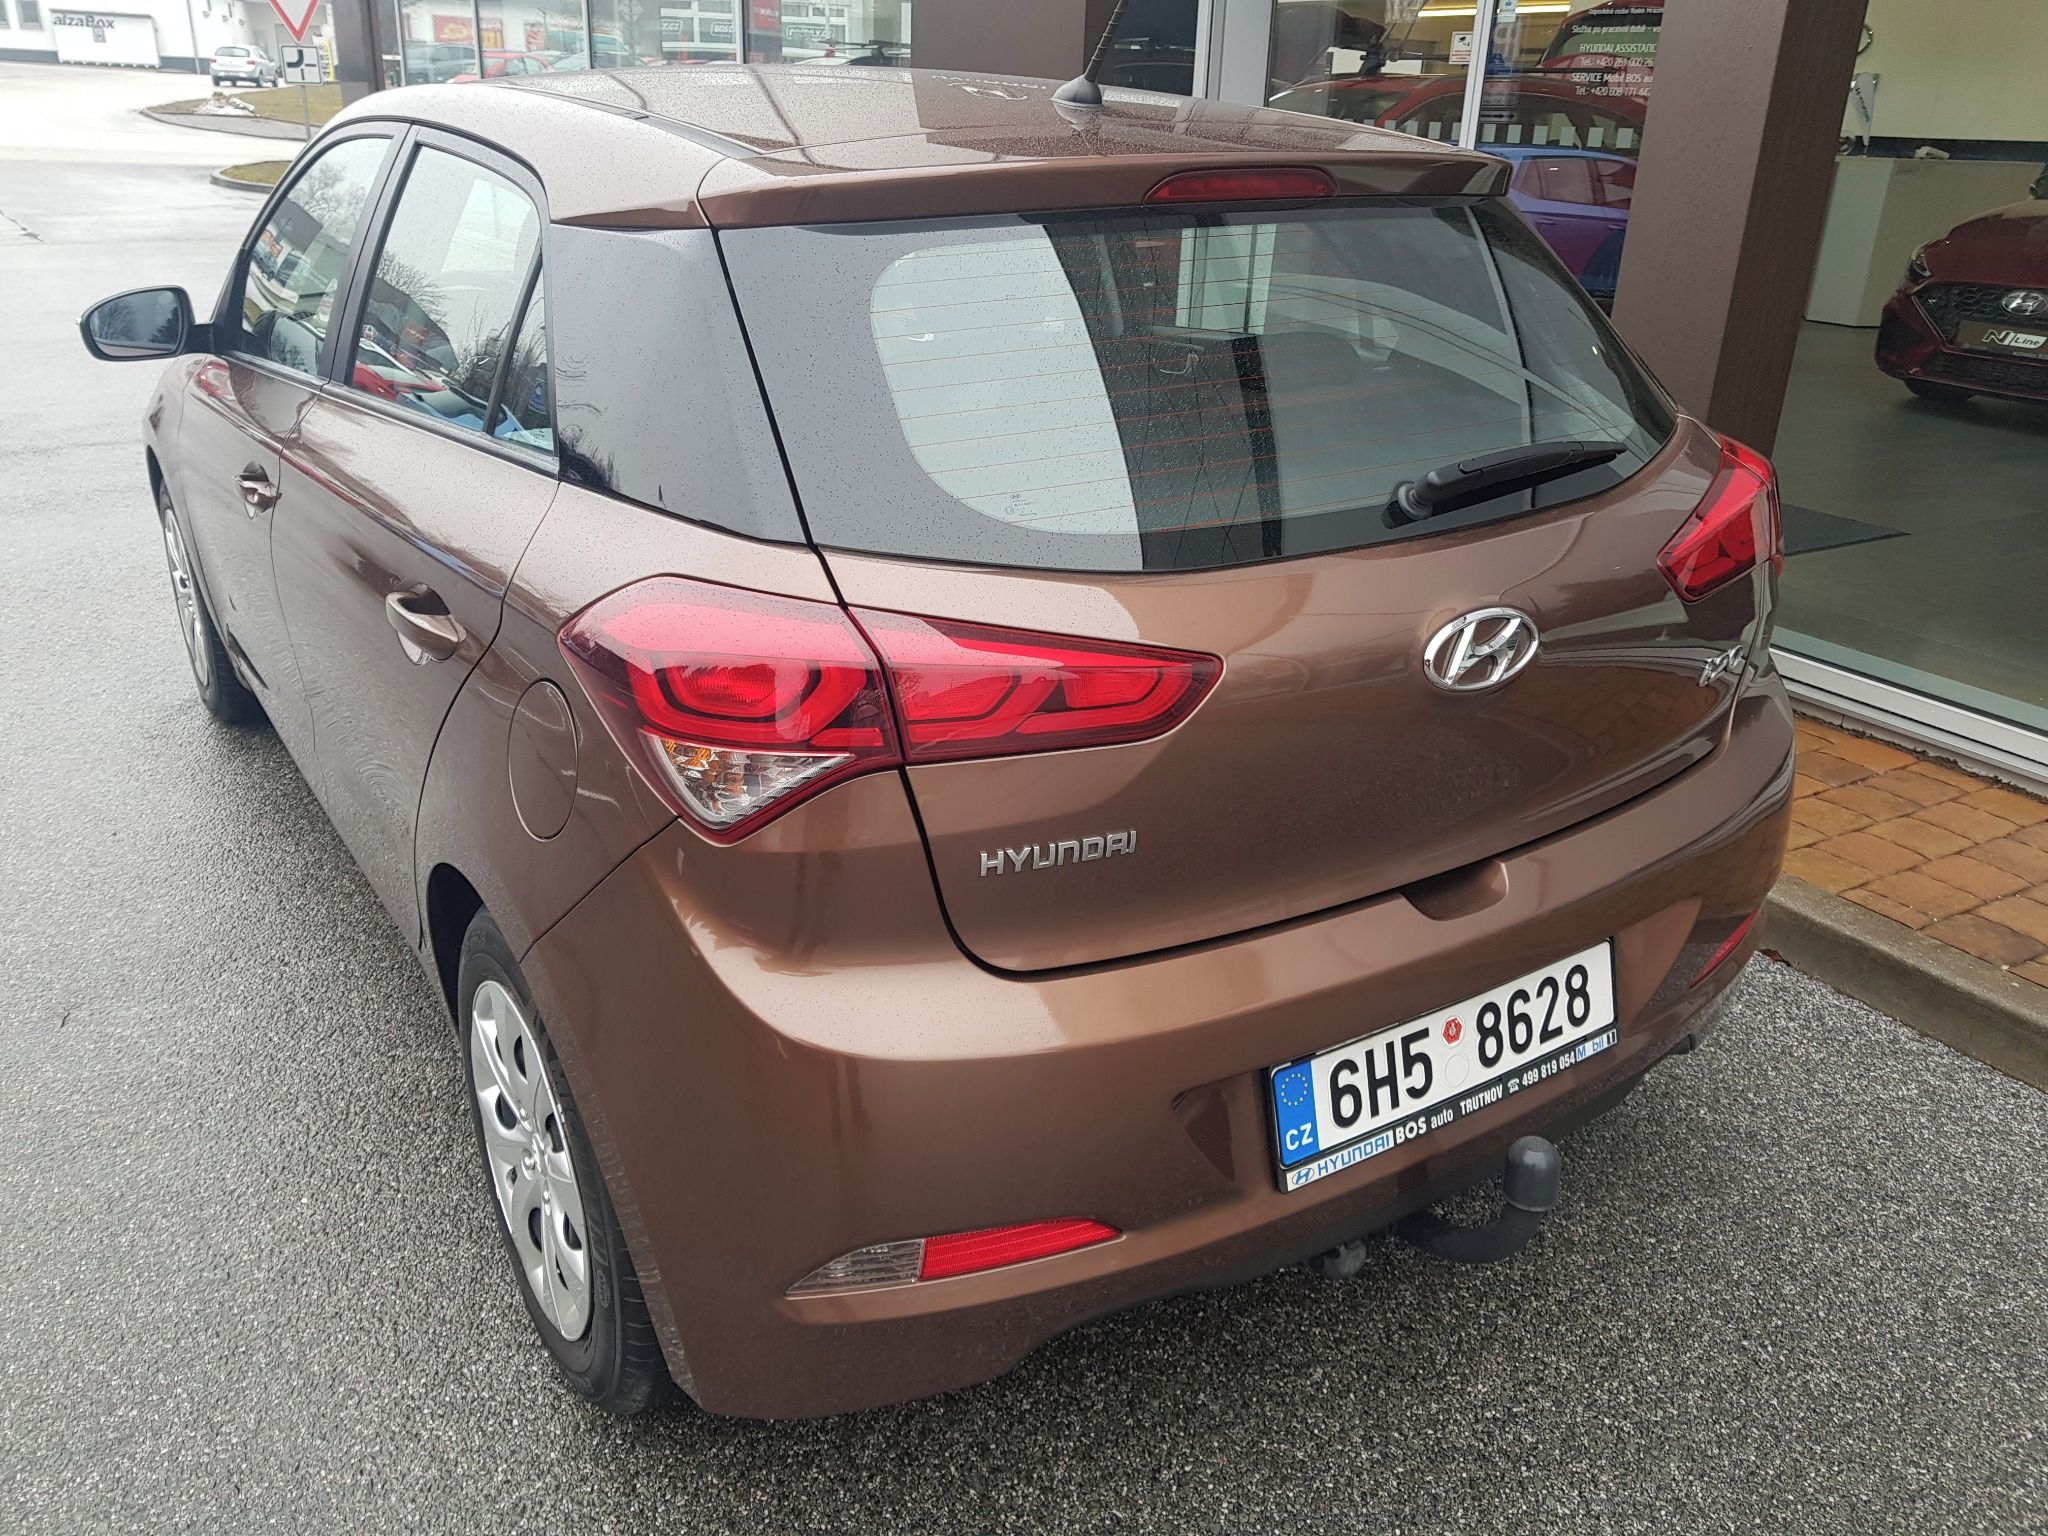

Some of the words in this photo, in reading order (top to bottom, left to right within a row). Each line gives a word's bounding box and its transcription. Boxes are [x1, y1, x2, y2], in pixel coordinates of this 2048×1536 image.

[53, 14, 115, 28] alzaBox
[1593, 27, 1602, 35] po
[1580, 43, 1614, 53] HYUNDAI
[1596, 57, 1614, 67] +420
[1571, 72, 1602, 82] SERVICE
[1625, 73, 1642, 83] BOS
[1590, 86, 1608, 96] +420
[2014, 337, 2041, 346] Line
[980, 829, 1137, 877] HYUNDAI
[1329, 1027, 1434, 1129] 6H5
[1475, 964, 1591, 1069] 8628
[1317, 1134, 1391, 1177] HYUNDAI
[1395, 1117, 1427, 1145] BOS
[1431, 1108, 1454, 1129] auto
[1460, 1085, 1503, 1116] TRUTNOV
[1522, 1070, 1539, 1087] 499
[1540, 1060, 1557, 1079] 819
[1559, 1051, 1576, 1070] 054
[1286, 1122, 1313, 1151] CZ
